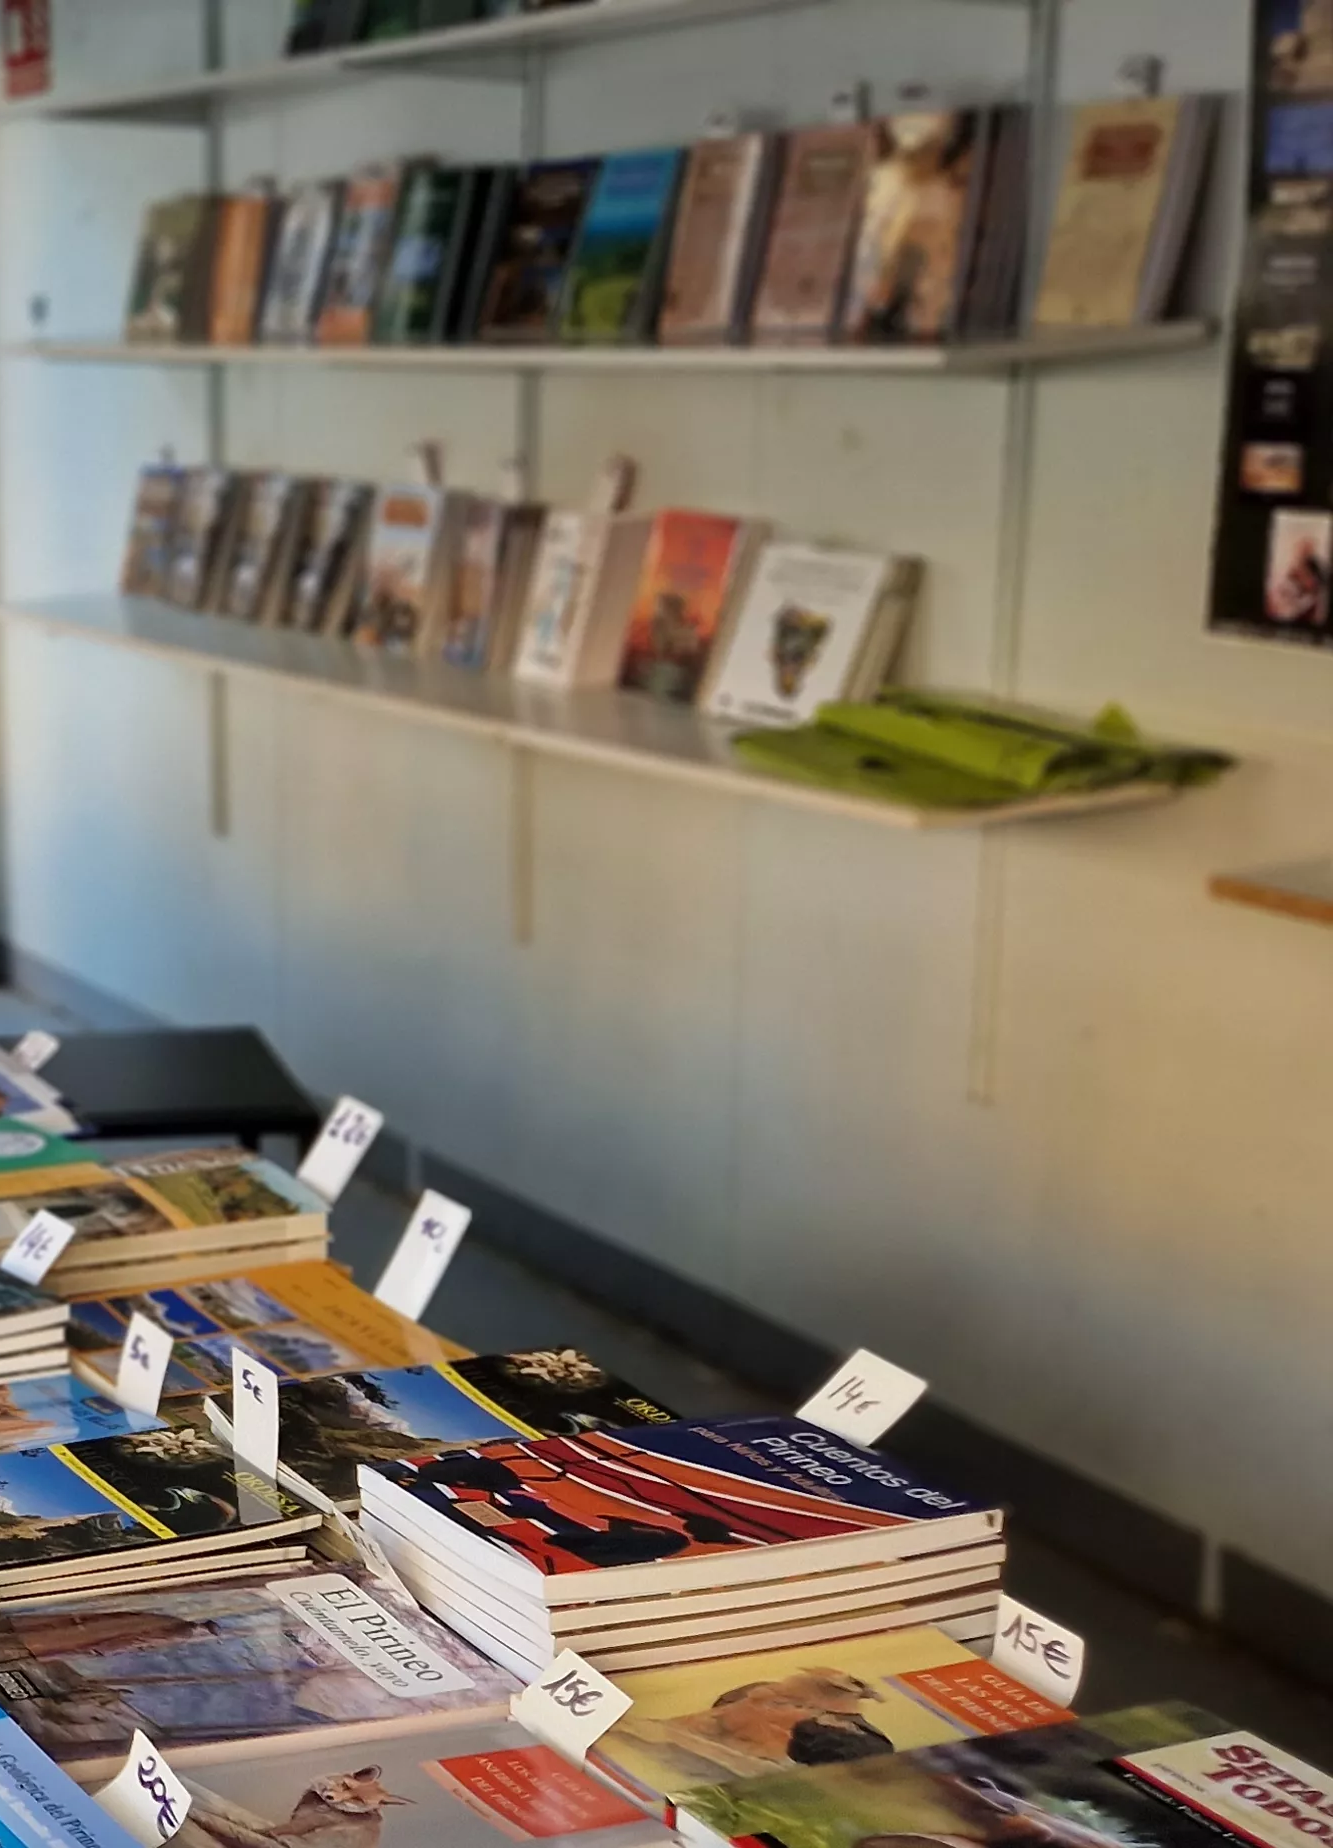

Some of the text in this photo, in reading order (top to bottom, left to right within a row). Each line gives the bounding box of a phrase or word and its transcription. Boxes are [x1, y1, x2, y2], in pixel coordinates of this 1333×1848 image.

[241, 1367, 265, 1405] 5€
[688, 1425, 730, 1446] para
[750, 1436, 854, 1487] Pirineo
[789, 1431, 970, 1511] Cuentos del
[317, 1586, 368, 1612] El
[346, 1612, 444, 1683] Pirineo
[1000, 1613, 1072, 1680] 15€
[540, 1669, 604, 1717] 15€
[916, 1673, 954, 1694] DEL
[953, 1677, 992, 1699] LAS
[42, 1802, 70, 1827] del
[1201, 1763, 1333, 1848] TODO
